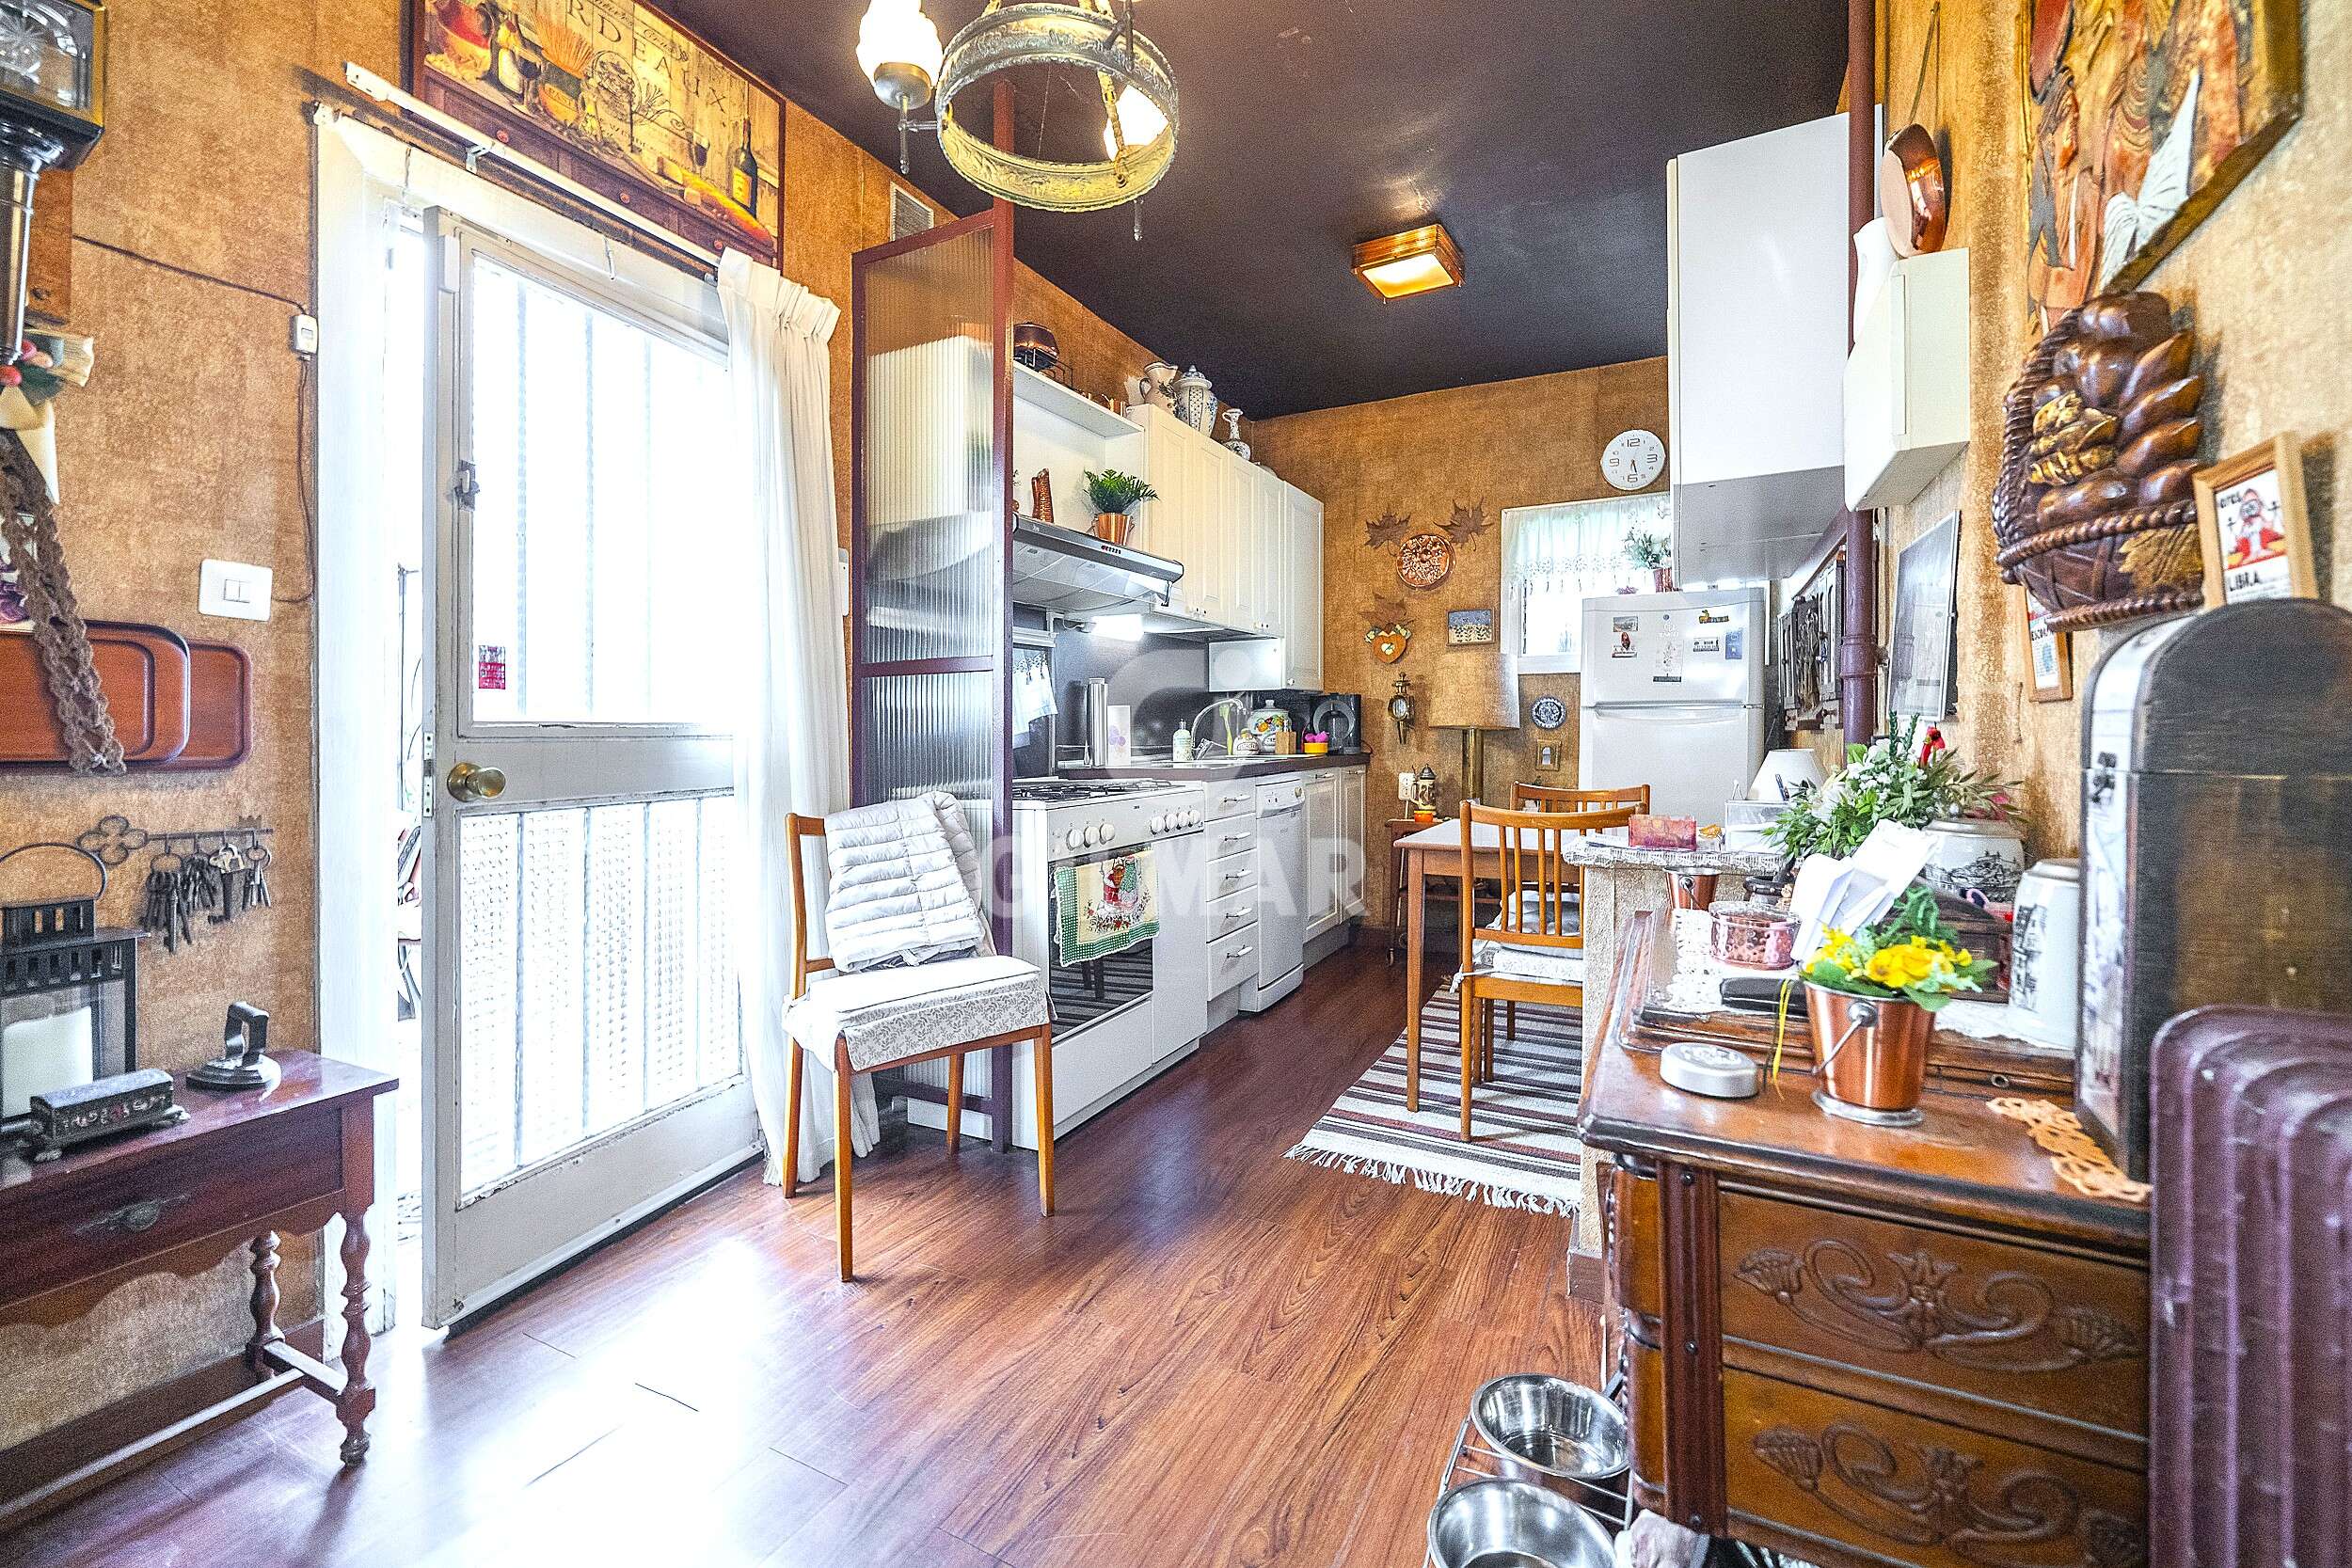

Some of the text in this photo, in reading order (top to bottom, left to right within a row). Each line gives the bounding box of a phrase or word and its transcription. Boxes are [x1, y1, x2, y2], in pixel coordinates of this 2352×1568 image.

[1627, 437, 1641, 448] 12
[1609, 457, 1620, 467] 9
[1646, 453, 1658, 464] 3
[1627, 473, 1638, 483] 6
